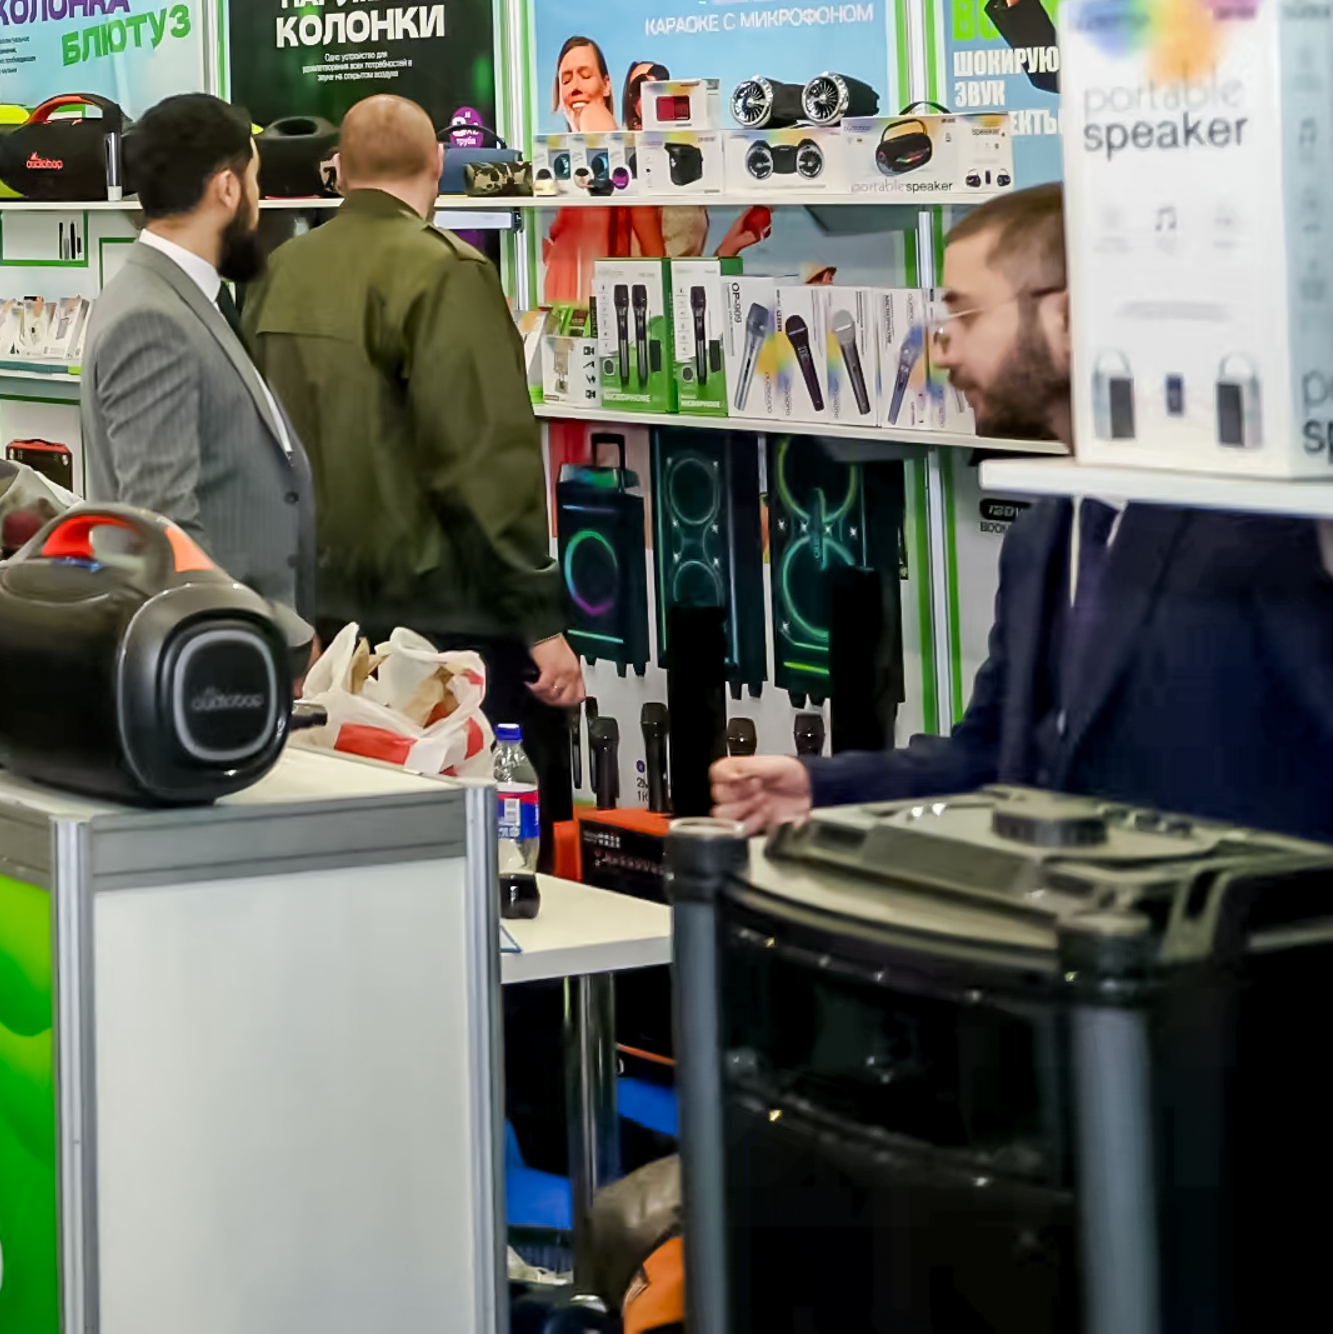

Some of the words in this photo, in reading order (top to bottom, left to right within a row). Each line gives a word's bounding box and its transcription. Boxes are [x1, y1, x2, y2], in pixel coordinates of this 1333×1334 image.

[61, 4, 191, 66] БЛЮТУЗ
[276, 4, 445, 48] КОЛОНКИ
[645, 14, 720, 36] КАРАОКЕ
[723, 14, 736, 31] С
[740, 3, 874, 28] МИКРОФОНОМ
[954, 80, 1006, 107] ЗВУК
[1083, 63, 1245, 117] portable
[1083, 112, 1250, 161] speaker
[851, 178, 905, 193] portable
[906, 181, 954, 194] speaker
